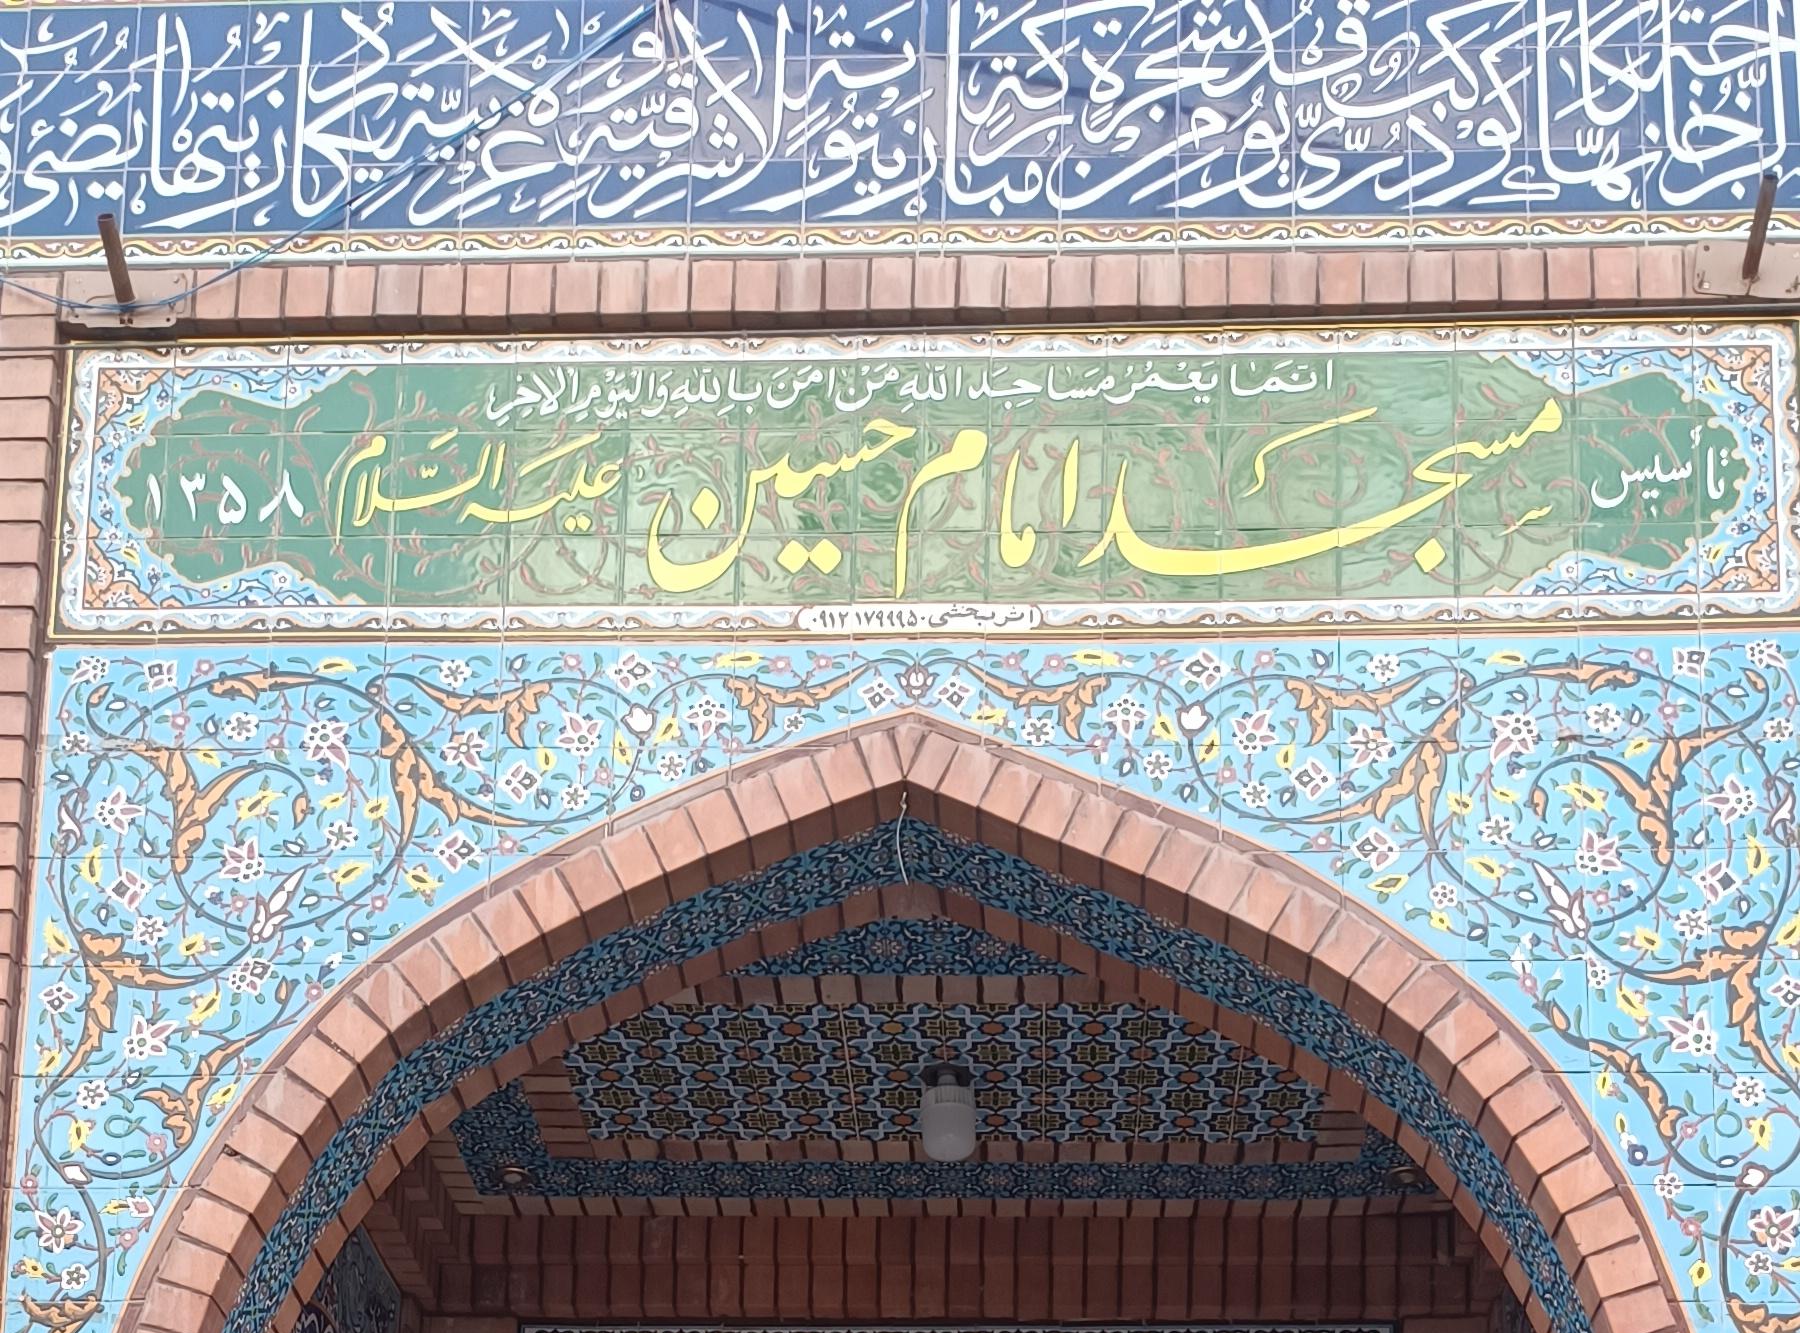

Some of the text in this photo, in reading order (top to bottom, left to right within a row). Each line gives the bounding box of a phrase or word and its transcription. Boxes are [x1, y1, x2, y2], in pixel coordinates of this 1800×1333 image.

[145, 470, 305, 526] ۱۳۵۸
[332, 396, 1564, 599] مسجد امام حسین علیه السلام
